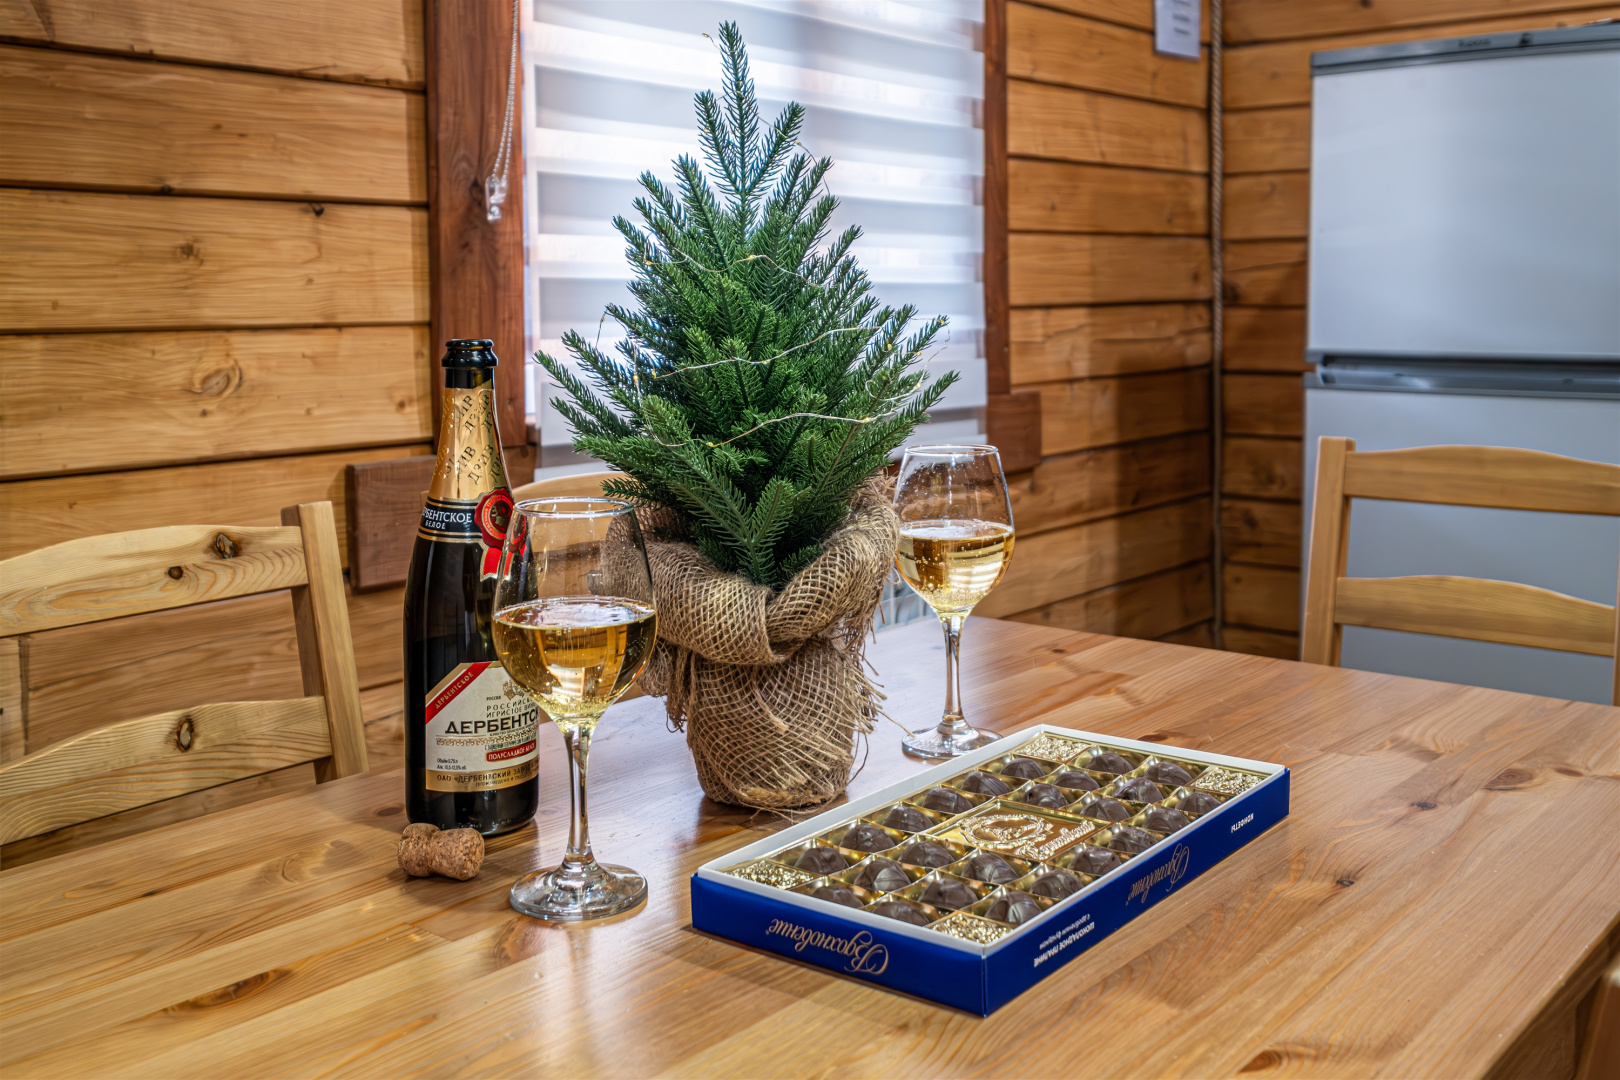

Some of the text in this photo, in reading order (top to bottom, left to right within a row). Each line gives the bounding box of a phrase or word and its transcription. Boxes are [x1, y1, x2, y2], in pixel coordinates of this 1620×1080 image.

[422, 506, 473, 523] РБЕНТСКОЕ
[425, 519, 446, 530] БЕЛОЕ
[435, 671, 474, 710] ДЕРБЕНТСКОЕ
[486, 705, 522, 718] ИГРИСТОЕ
[488, 746, 525, 760] ПОЛУСЛАДКОЕ
[436, 774, 452, 782] ОАО
[1230, 813, 1254, 833] КОНФЕТЫ
[767, 918, 889, 975] Вдохновение
